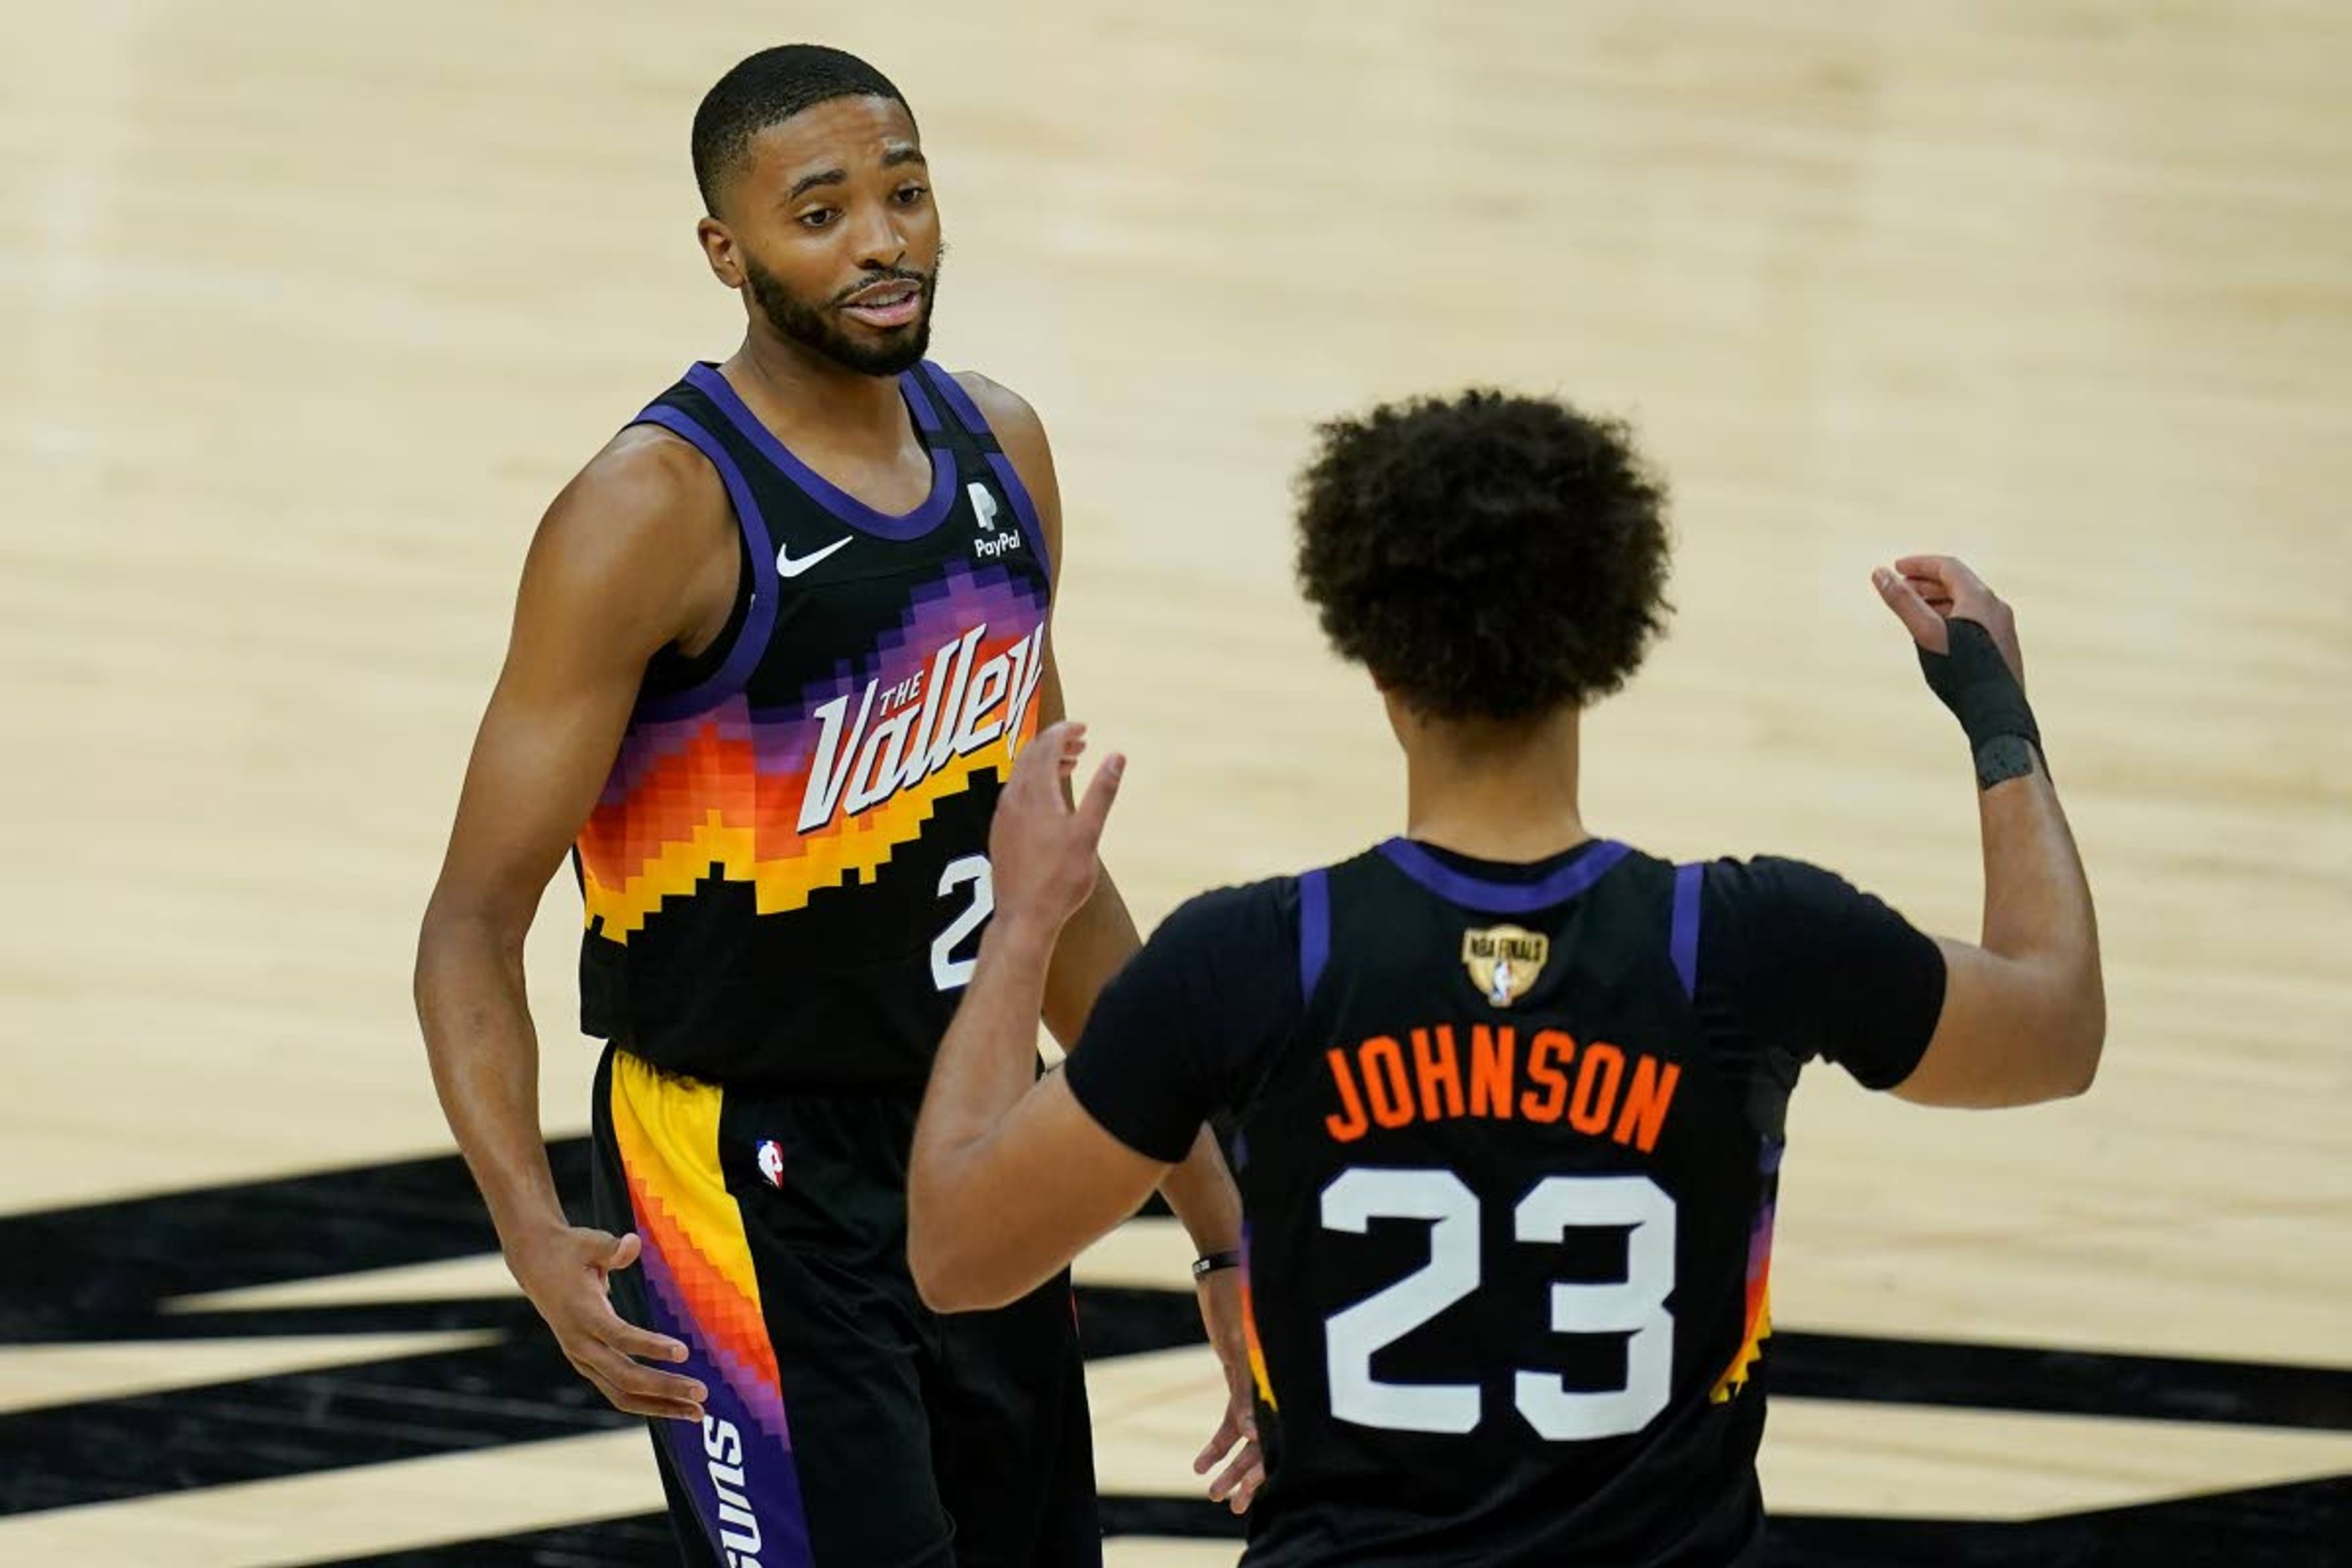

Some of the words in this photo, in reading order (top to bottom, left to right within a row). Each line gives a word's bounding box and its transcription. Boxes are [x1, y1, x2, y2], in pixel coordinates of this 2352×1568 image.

[974, 529, 1020, 558] PayPal
[797, 622, 1044, 834] Valley
[880, 670, 924, 716] THE
[1325, 1024, 1681, 1153] JOHNSON
[1321, 1167, 1677, 1441] 23
